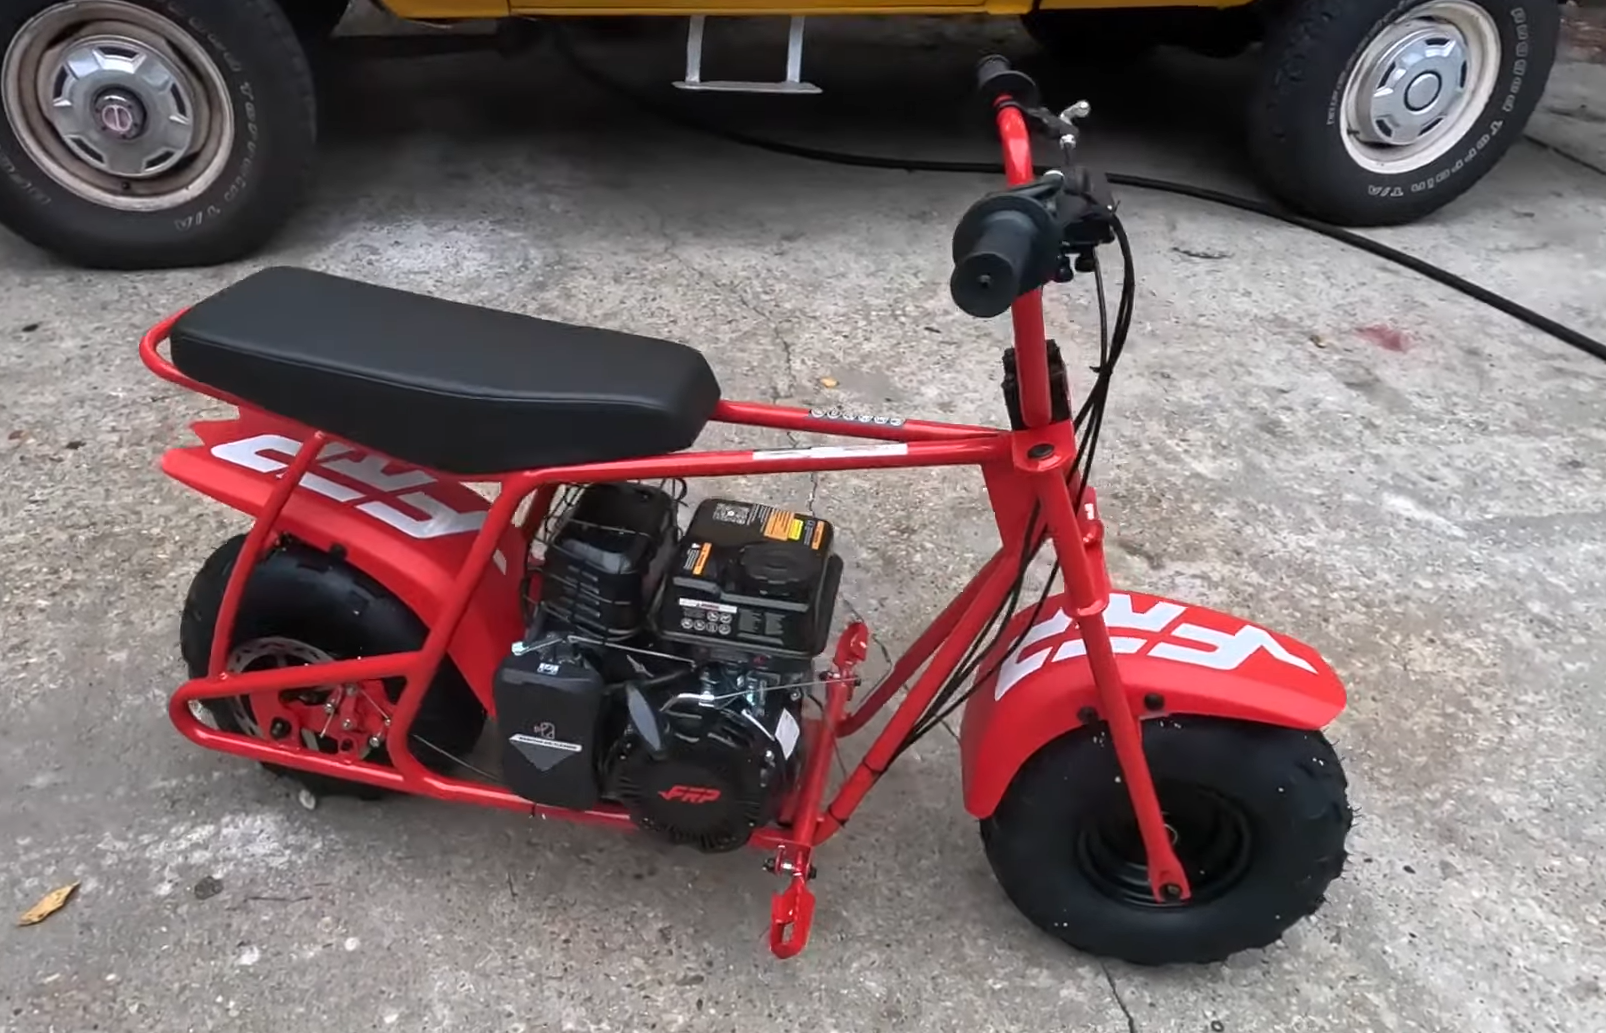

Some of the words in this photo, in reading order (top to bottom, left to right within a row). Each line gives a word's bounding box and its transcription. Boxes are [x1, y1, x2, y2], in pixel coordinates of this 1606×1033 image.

[1411, 118, 1503, 192] Terrain
[1368, 184, 1404, 197] T/A
[658, 784, 721, 803] FRP
